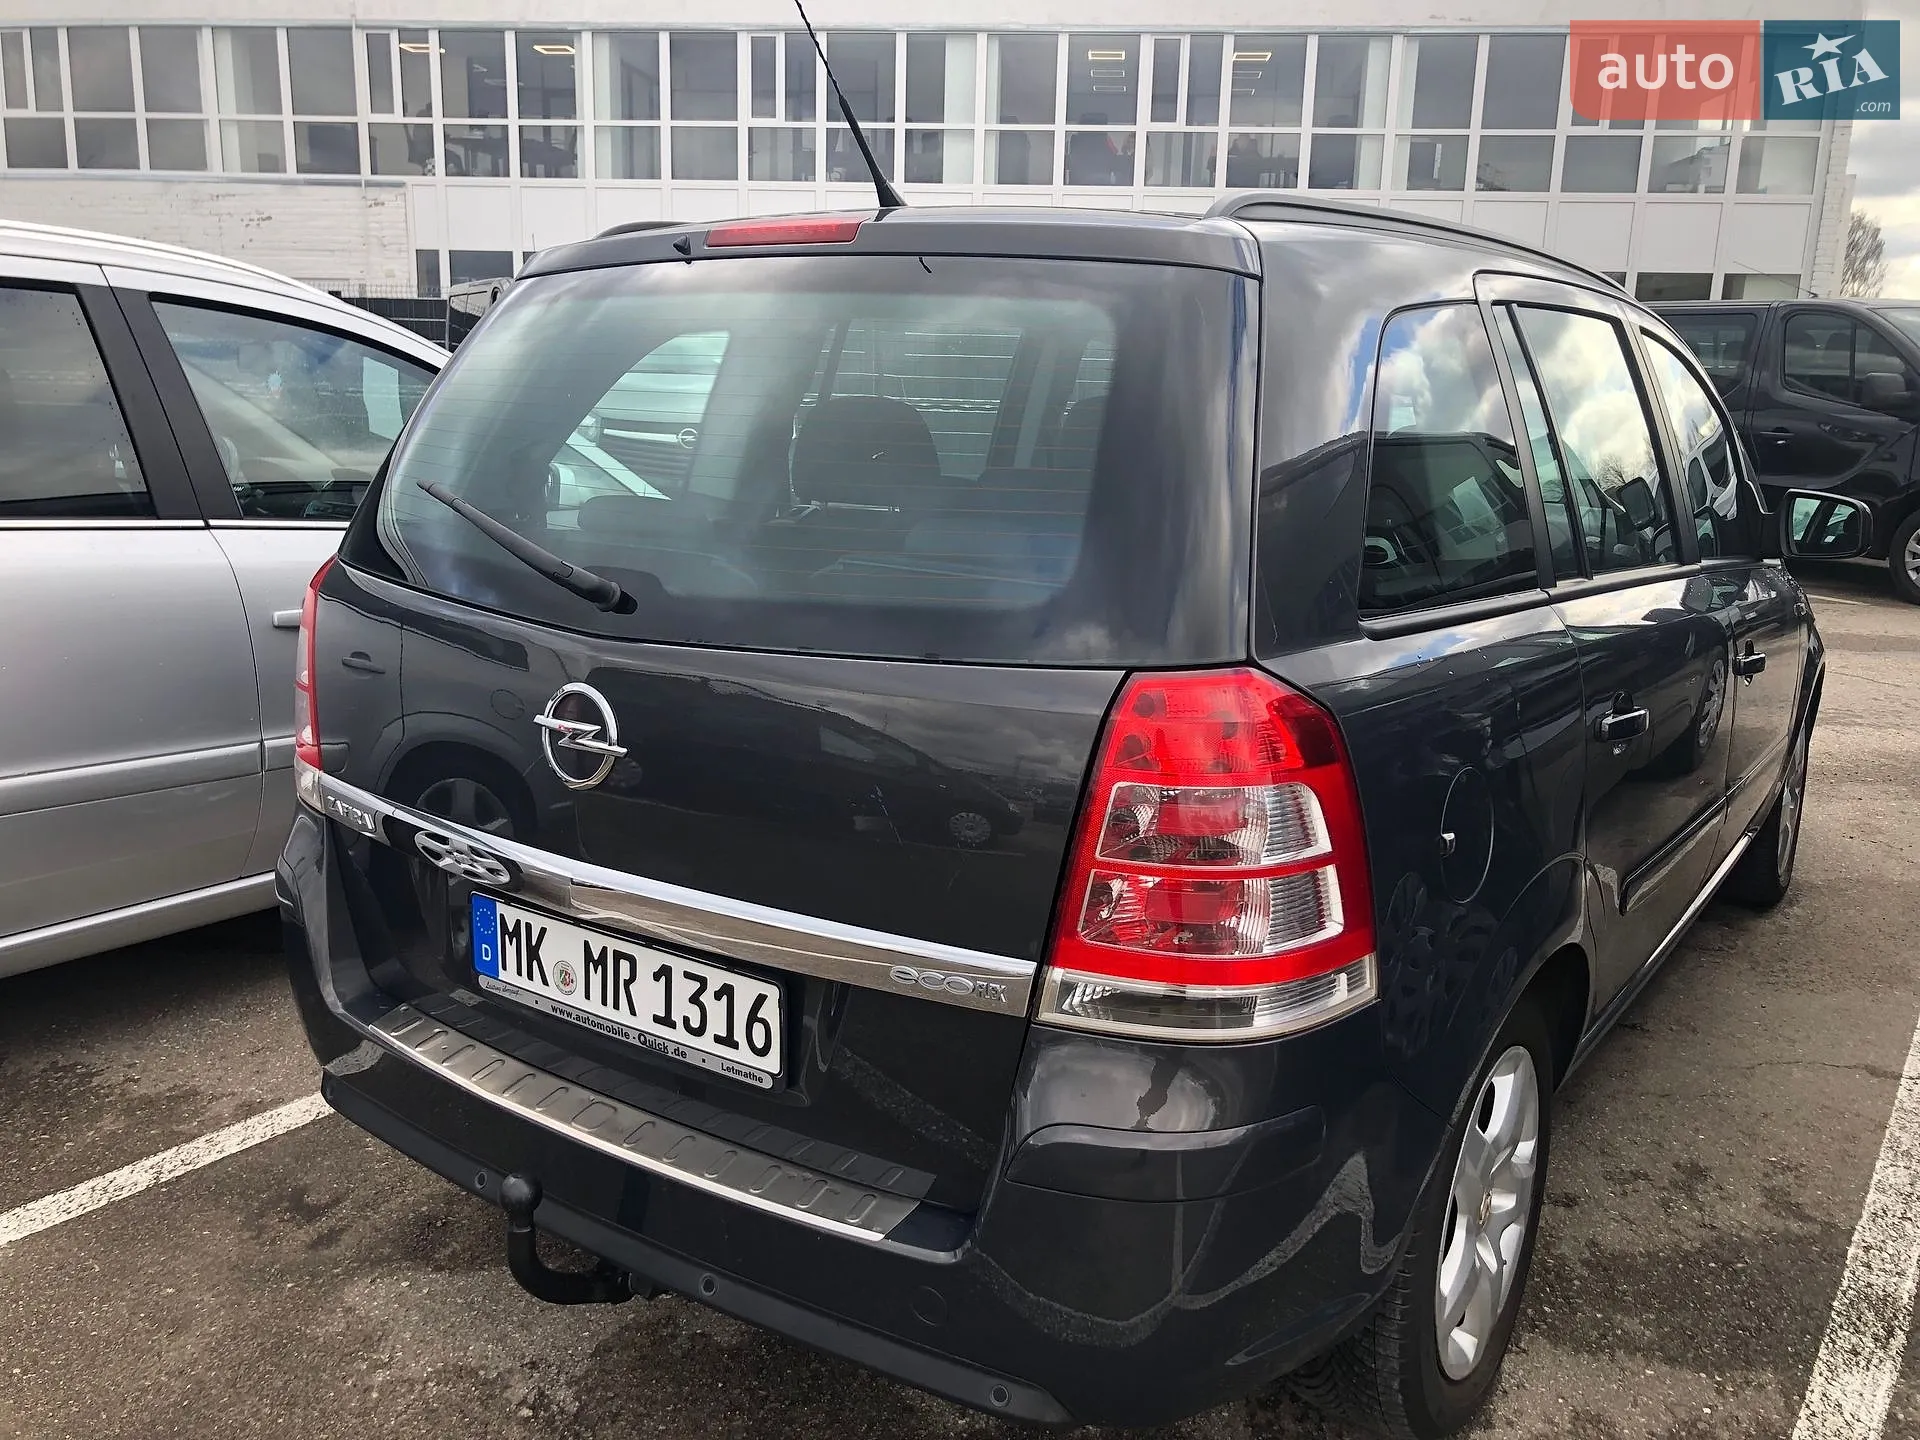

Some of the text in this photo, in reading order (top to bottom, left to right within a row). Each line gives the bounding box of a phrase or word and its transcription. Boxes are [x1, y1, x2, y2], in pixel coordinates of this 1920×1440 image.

[482, 943, 492, 961] D
[499, 912, 550, 987] MK
[583, 939, 638, 1017] MR
[652, 963, 772, 1058] 1316
[721, 1062, 764, 1084] Letmathe
